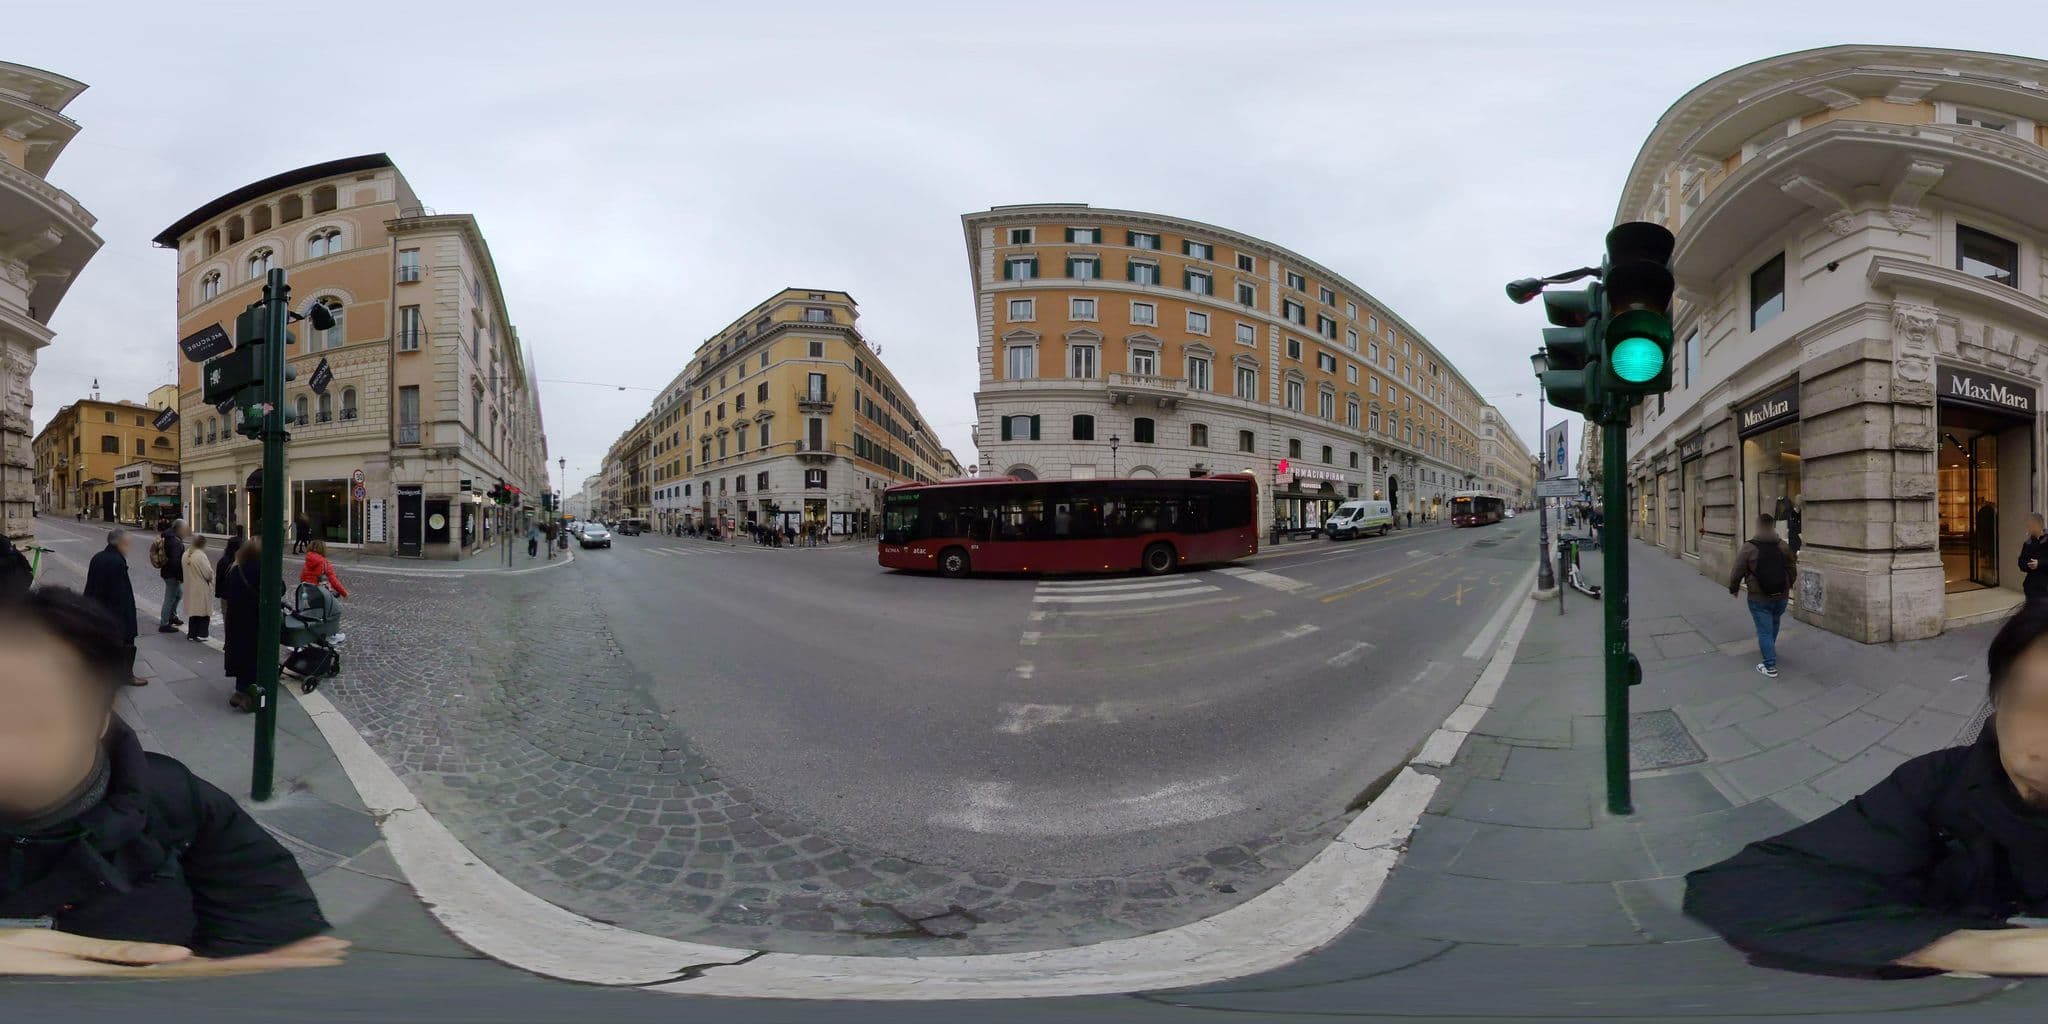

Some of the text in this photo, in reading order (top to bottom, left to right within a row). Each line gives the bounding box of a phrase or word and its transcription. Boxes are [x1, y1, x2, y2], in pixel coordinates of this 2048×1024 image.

[1950, 374, 2028, 410] MaxMara
[1744, 400, 1789, 428] MaxMara
[1325, 471, 1345, 481] PIRAM
